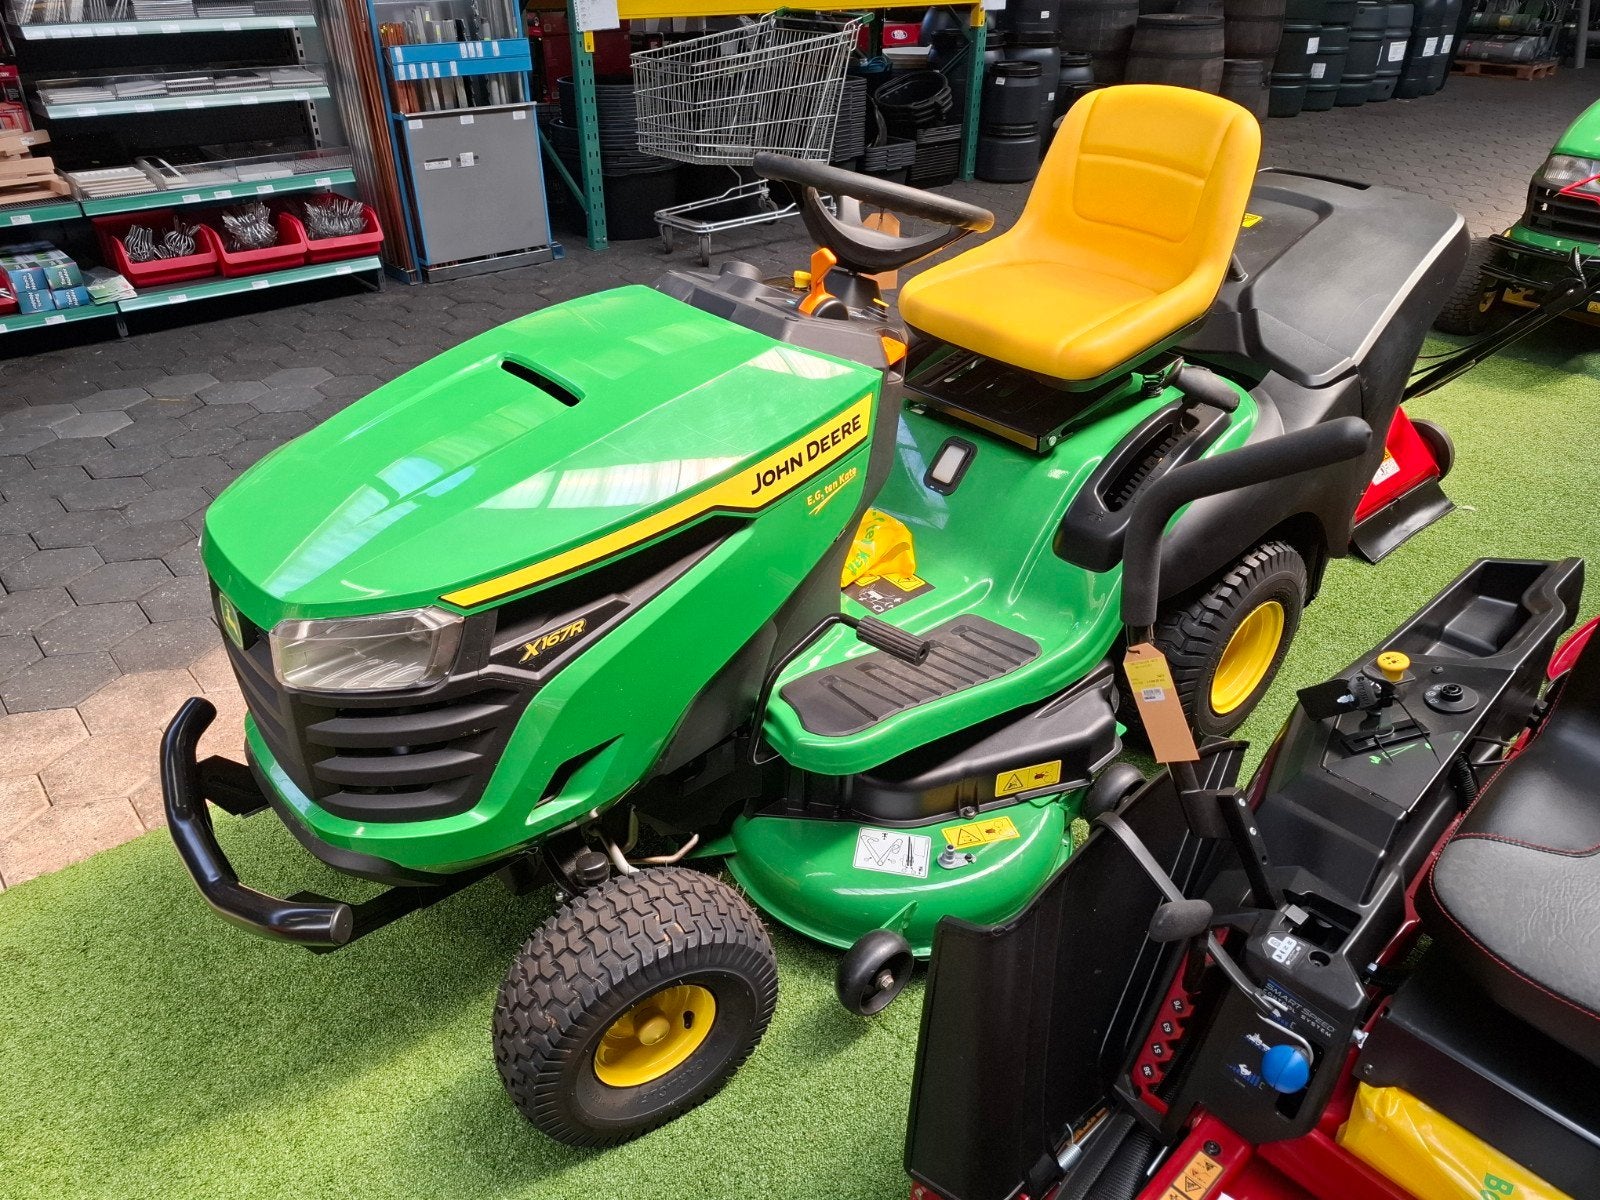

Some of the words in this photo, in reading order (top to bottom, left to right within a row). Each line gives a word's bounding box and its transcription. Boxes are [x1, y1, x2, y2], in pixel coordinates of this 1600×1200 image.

[751, 451, 803, 496] JOHN
[806, 413, 862, 462] DEERE
[520, 618, 586, 662] X167R
[1265, 981, 1303, 1009] SMART
[1301, 1007, 1336, 1033] SPEED
[1300, 1014, 1333, 1038] SYSTEM
